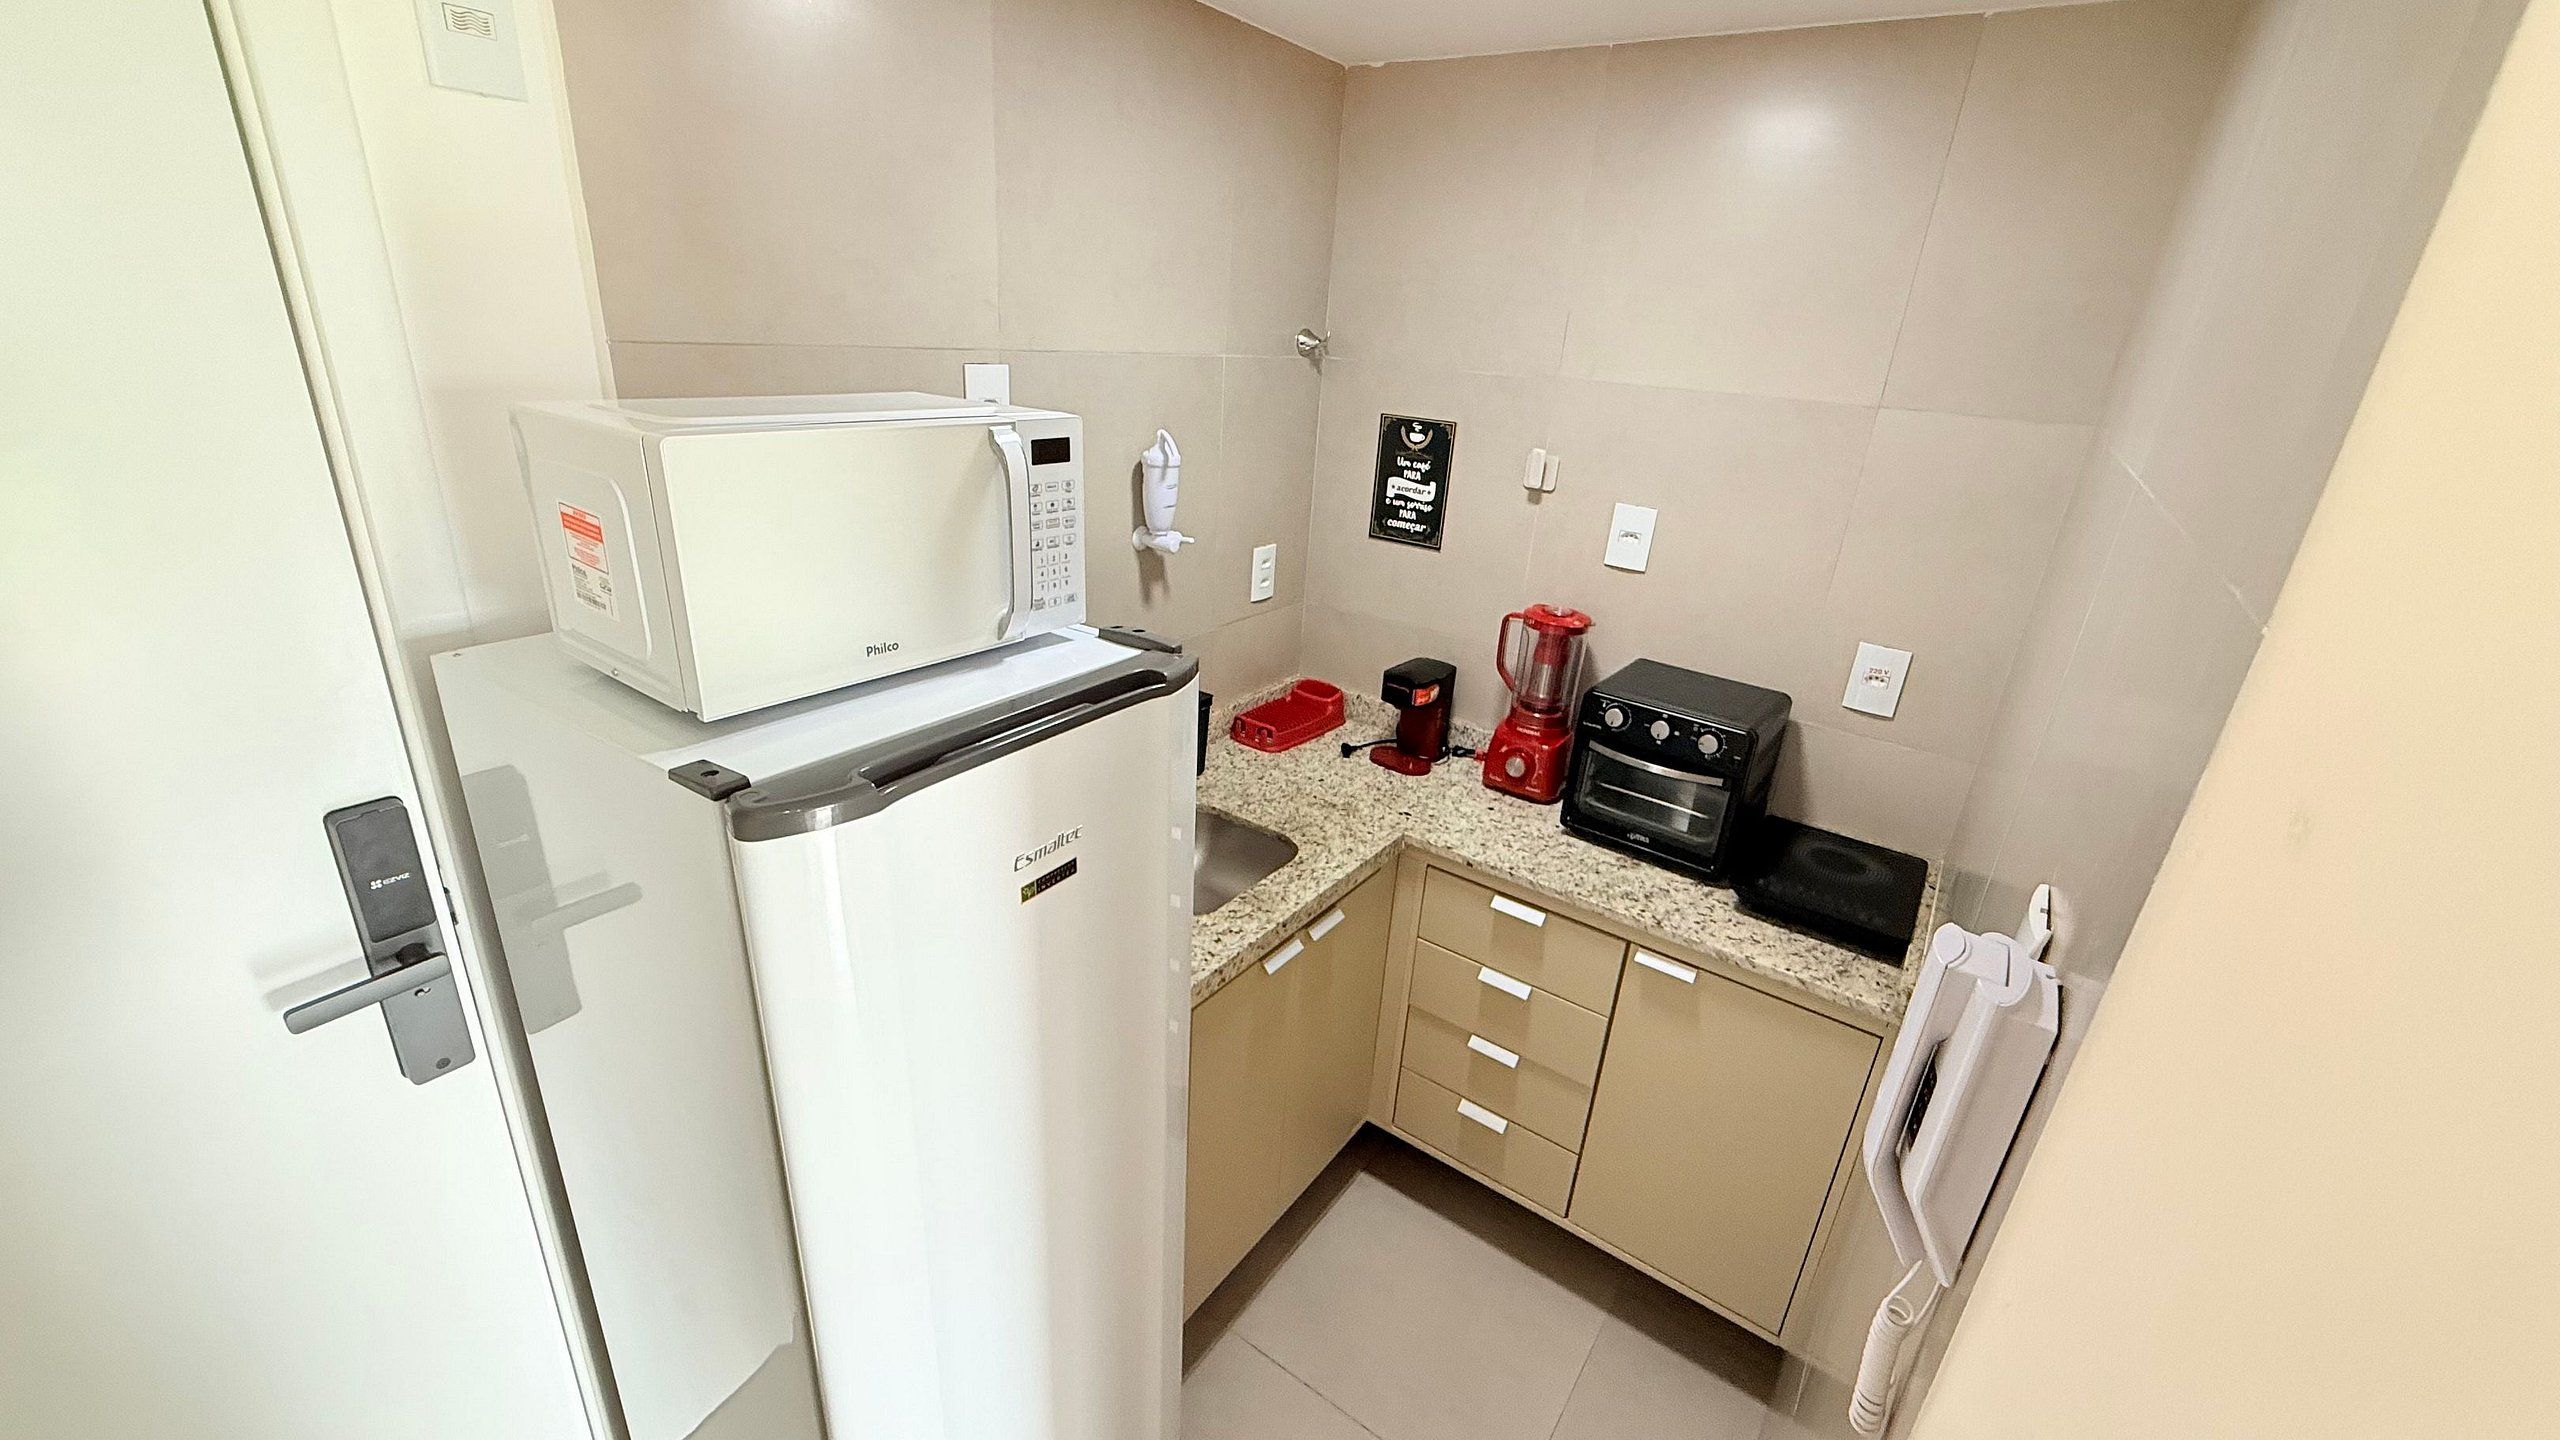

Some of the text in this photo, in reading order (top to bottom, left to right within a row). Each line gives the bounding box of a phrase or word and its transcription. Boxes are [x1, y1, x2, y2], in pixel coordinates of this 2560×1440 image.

[1397, 456, 1431, 473] Um café
[1403, 469, 1421, 481] PARA
[1396, 485, 1426, 495] acordar
[1392, 499, 1406, 507] um
[1399, 509, 1417, 520] PARA
[1386, 519, 1427, 533] começar
[866, 642, 899, 657] Philco
[1013, 826, 1083, 872] Esmaltec
